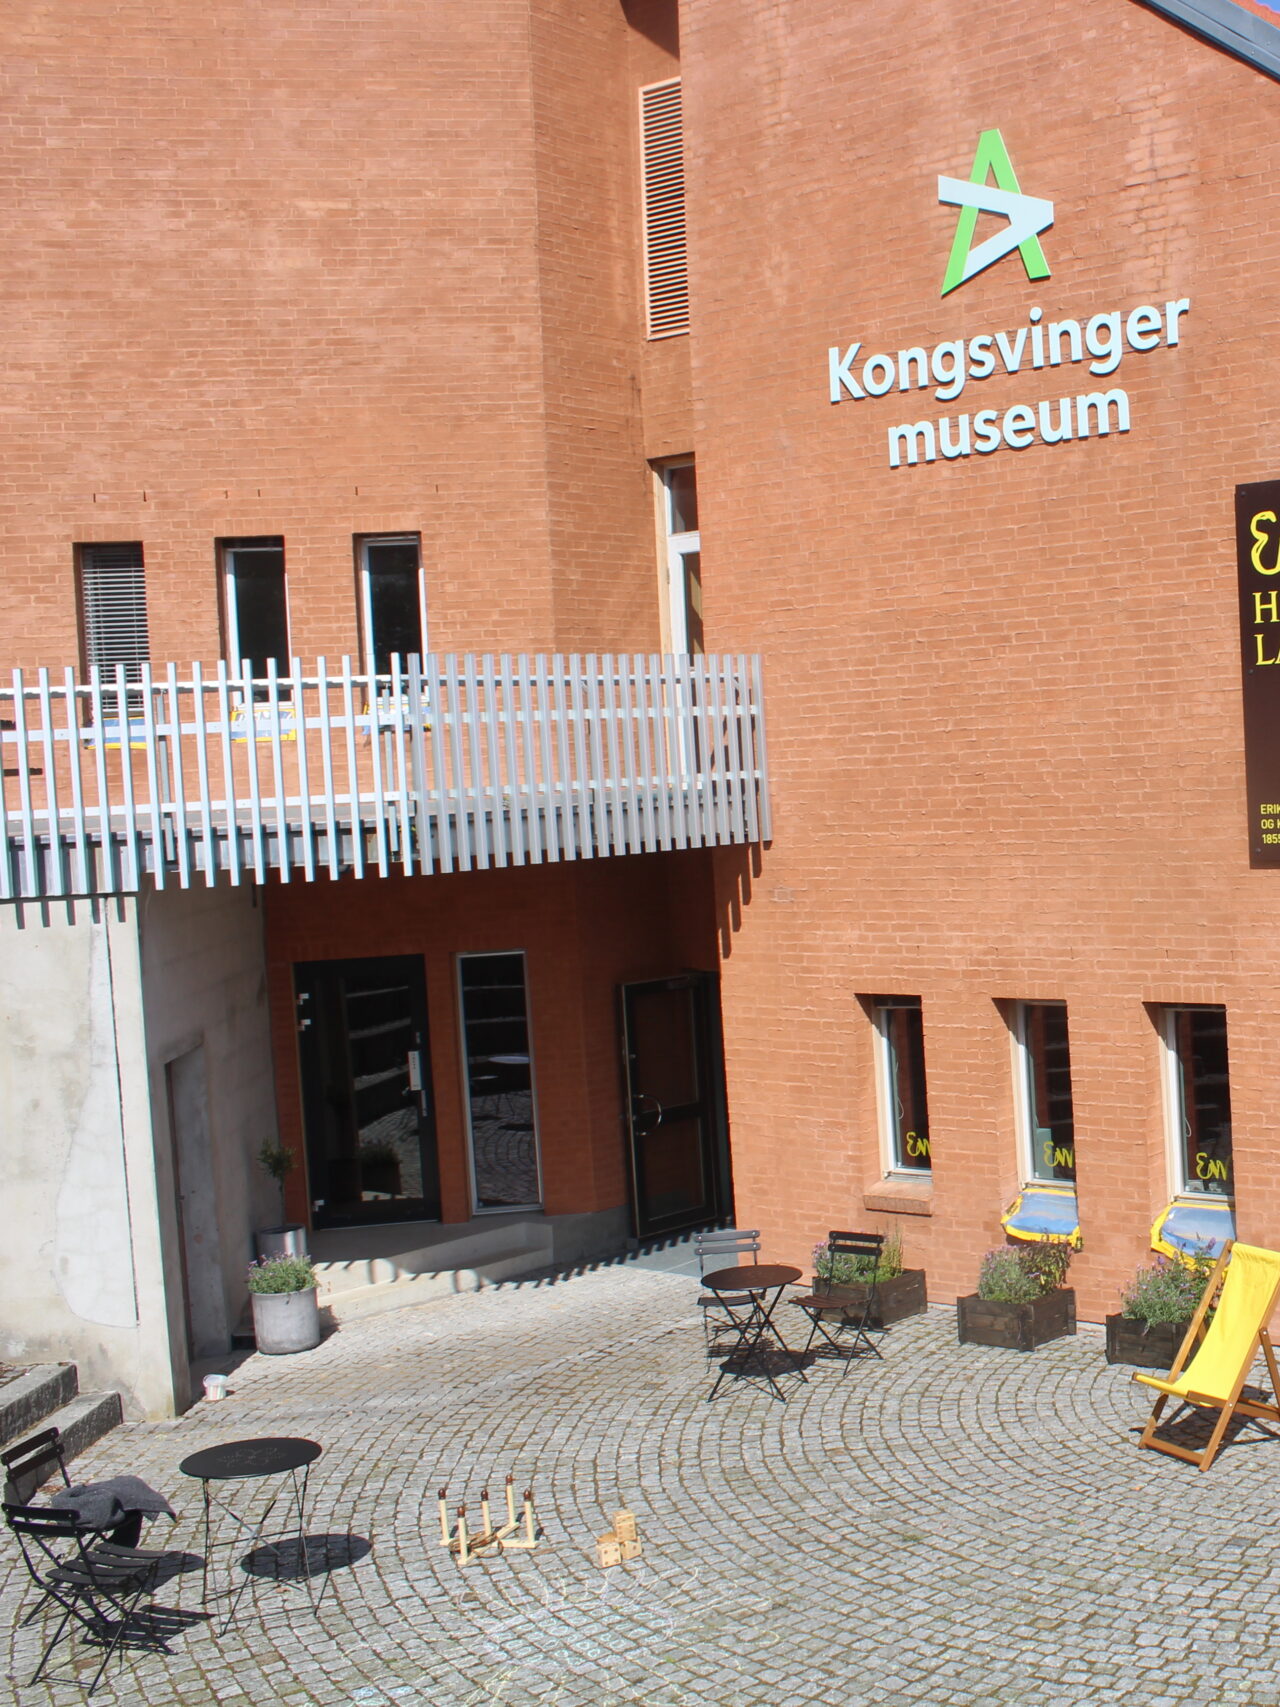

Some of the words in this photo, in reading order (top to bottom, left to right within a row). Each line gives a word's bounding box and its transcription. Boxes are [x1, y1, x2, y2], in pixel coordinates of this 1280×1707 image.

[828, 298, 1190, 403] Kongsvinger
[888, 388, 1130, 469] museum
[1260, 818, 1275, 829] OG
